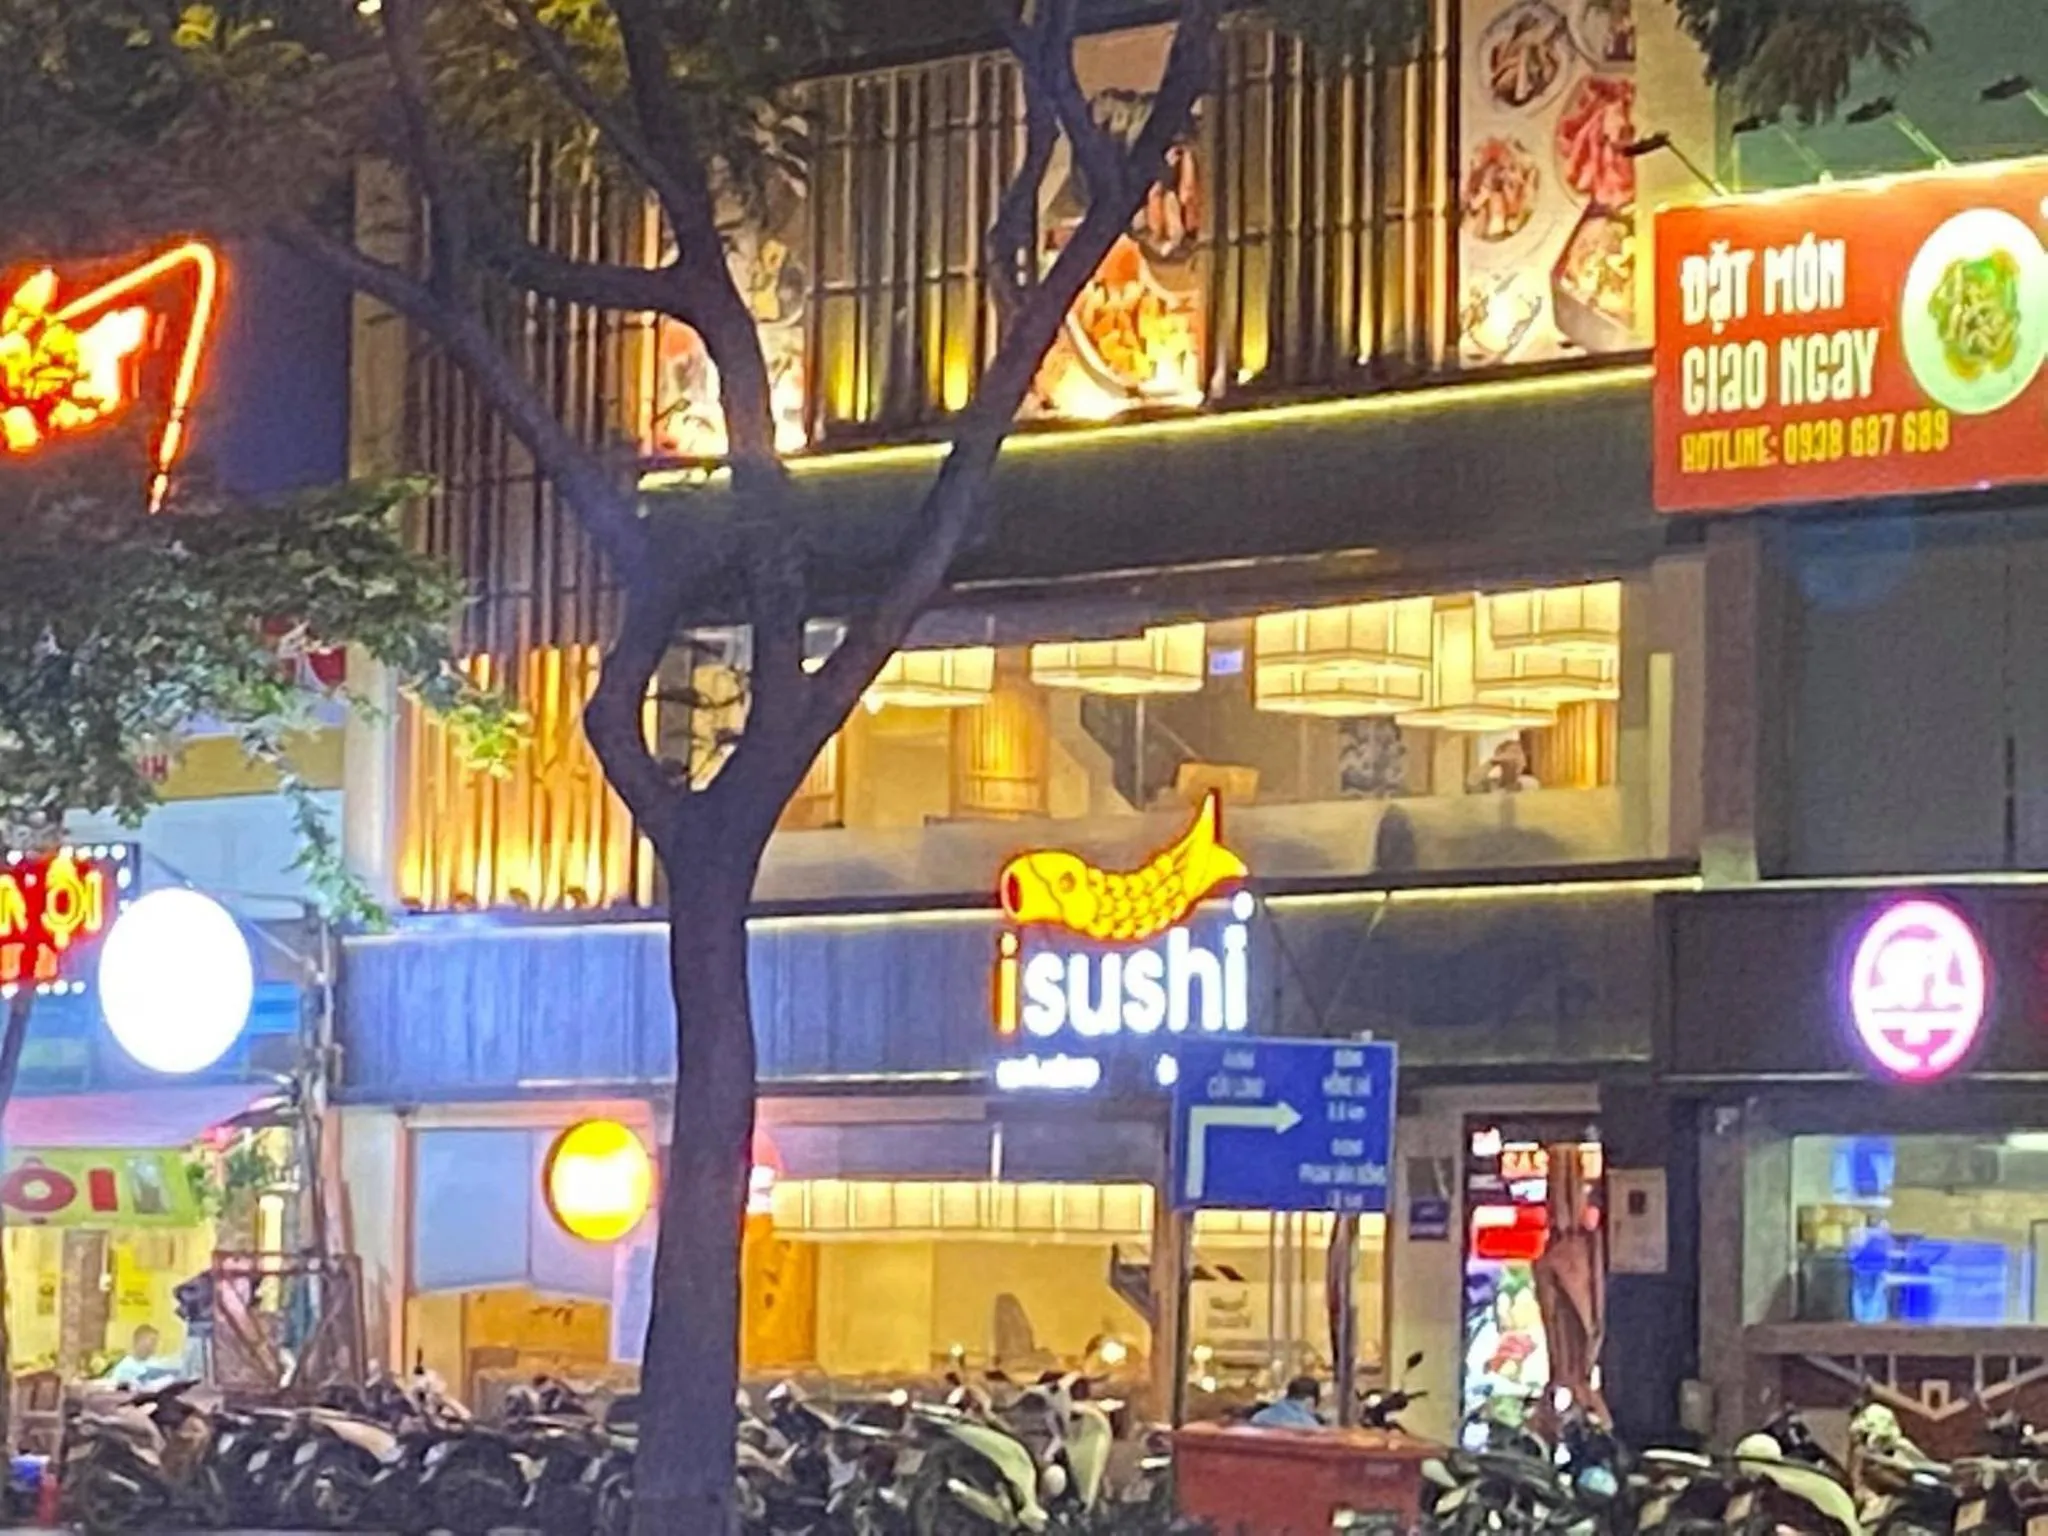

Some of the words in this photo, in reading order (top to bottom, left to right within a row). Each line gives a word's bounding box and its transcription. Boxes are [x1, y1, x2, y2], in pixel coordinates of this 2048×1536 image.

[1763, 232, 1846, 317] MÓN
[1680, 425, 1779, 474] HOTLINE:
[998, 890, 1254, 1036] isushi
